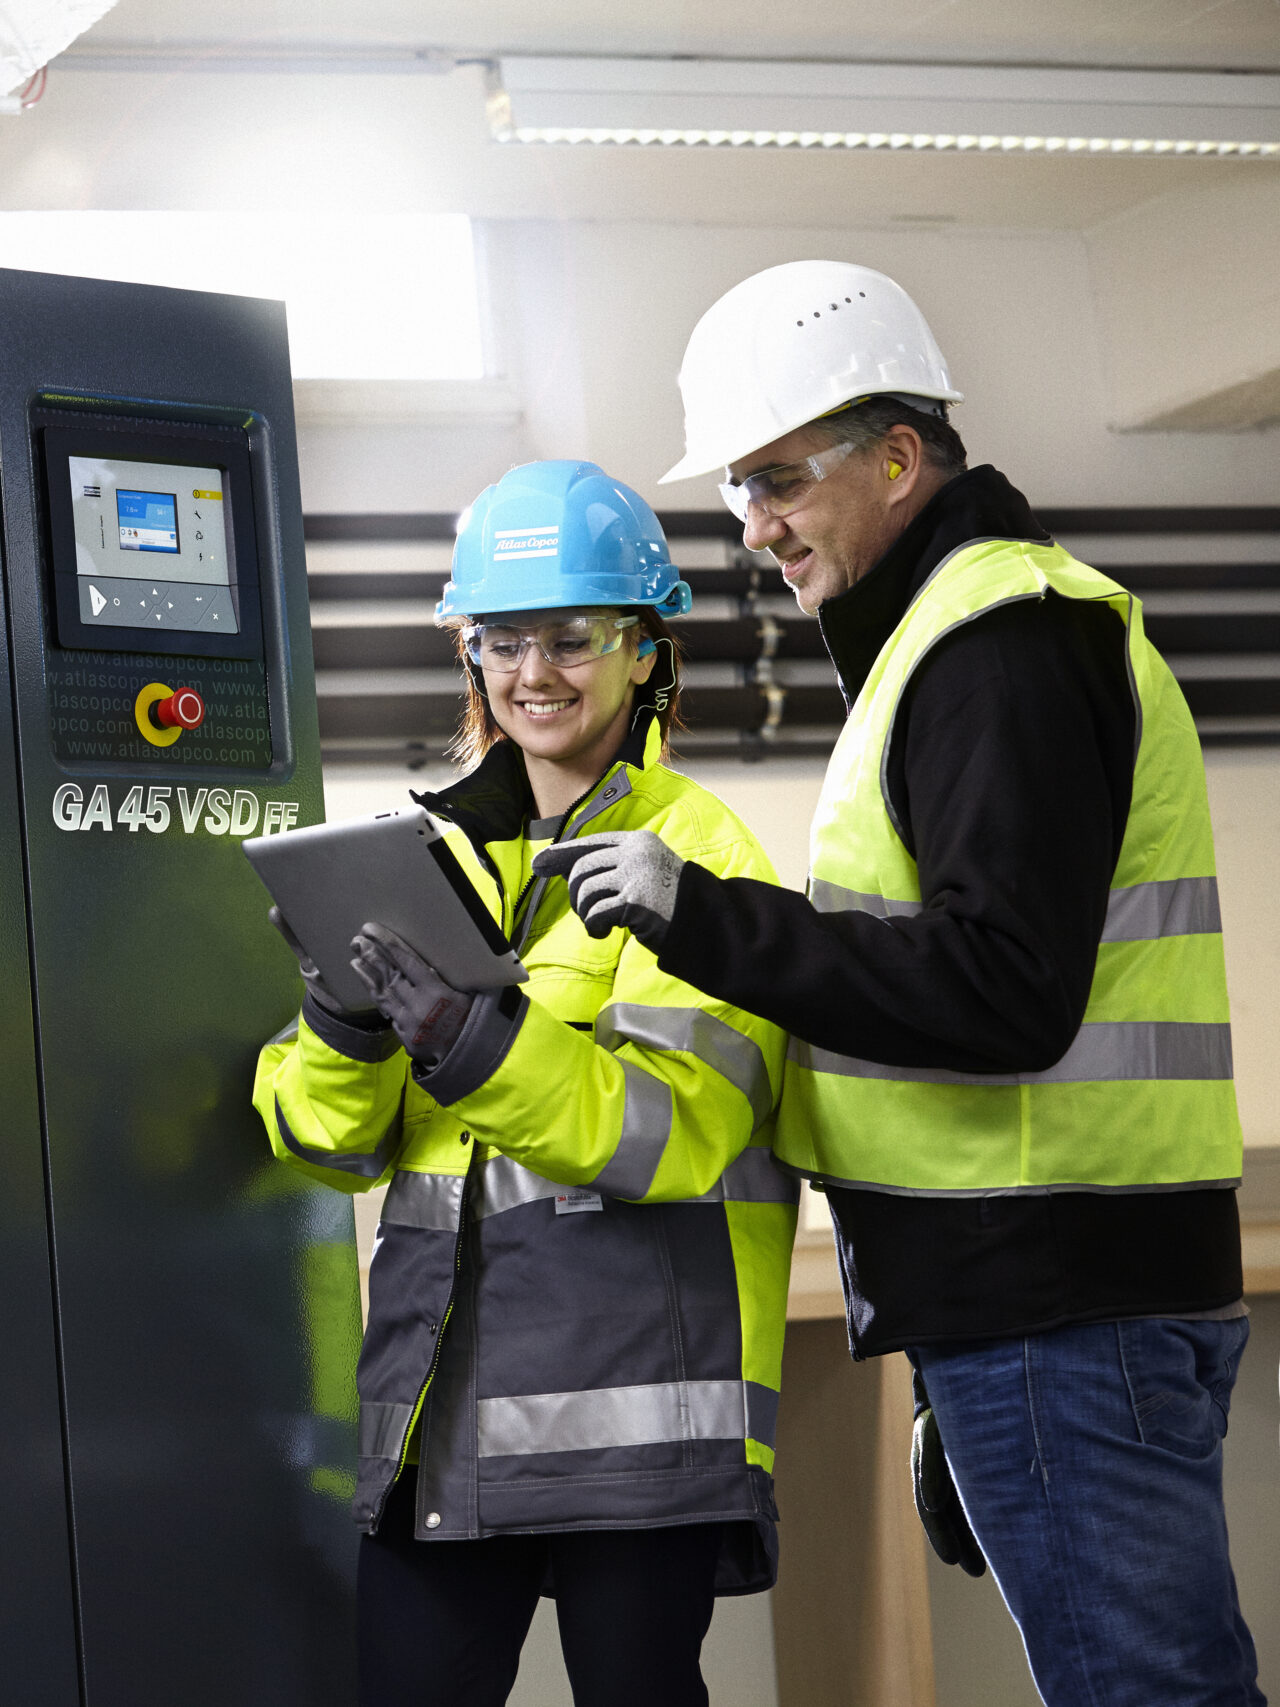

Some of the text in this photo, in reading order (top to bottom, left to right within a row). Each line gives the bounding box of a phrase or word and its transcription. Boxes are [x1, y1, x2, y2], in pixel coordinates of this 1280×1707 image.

[494, 537, 559, 551] Atlas Copco
[67, 740, 256, 763] www.atlascopco.com
[52, 783, 113, 832] GA
[117, 786, 171, 834] 45
[177, 788, 259, 836] VSD
